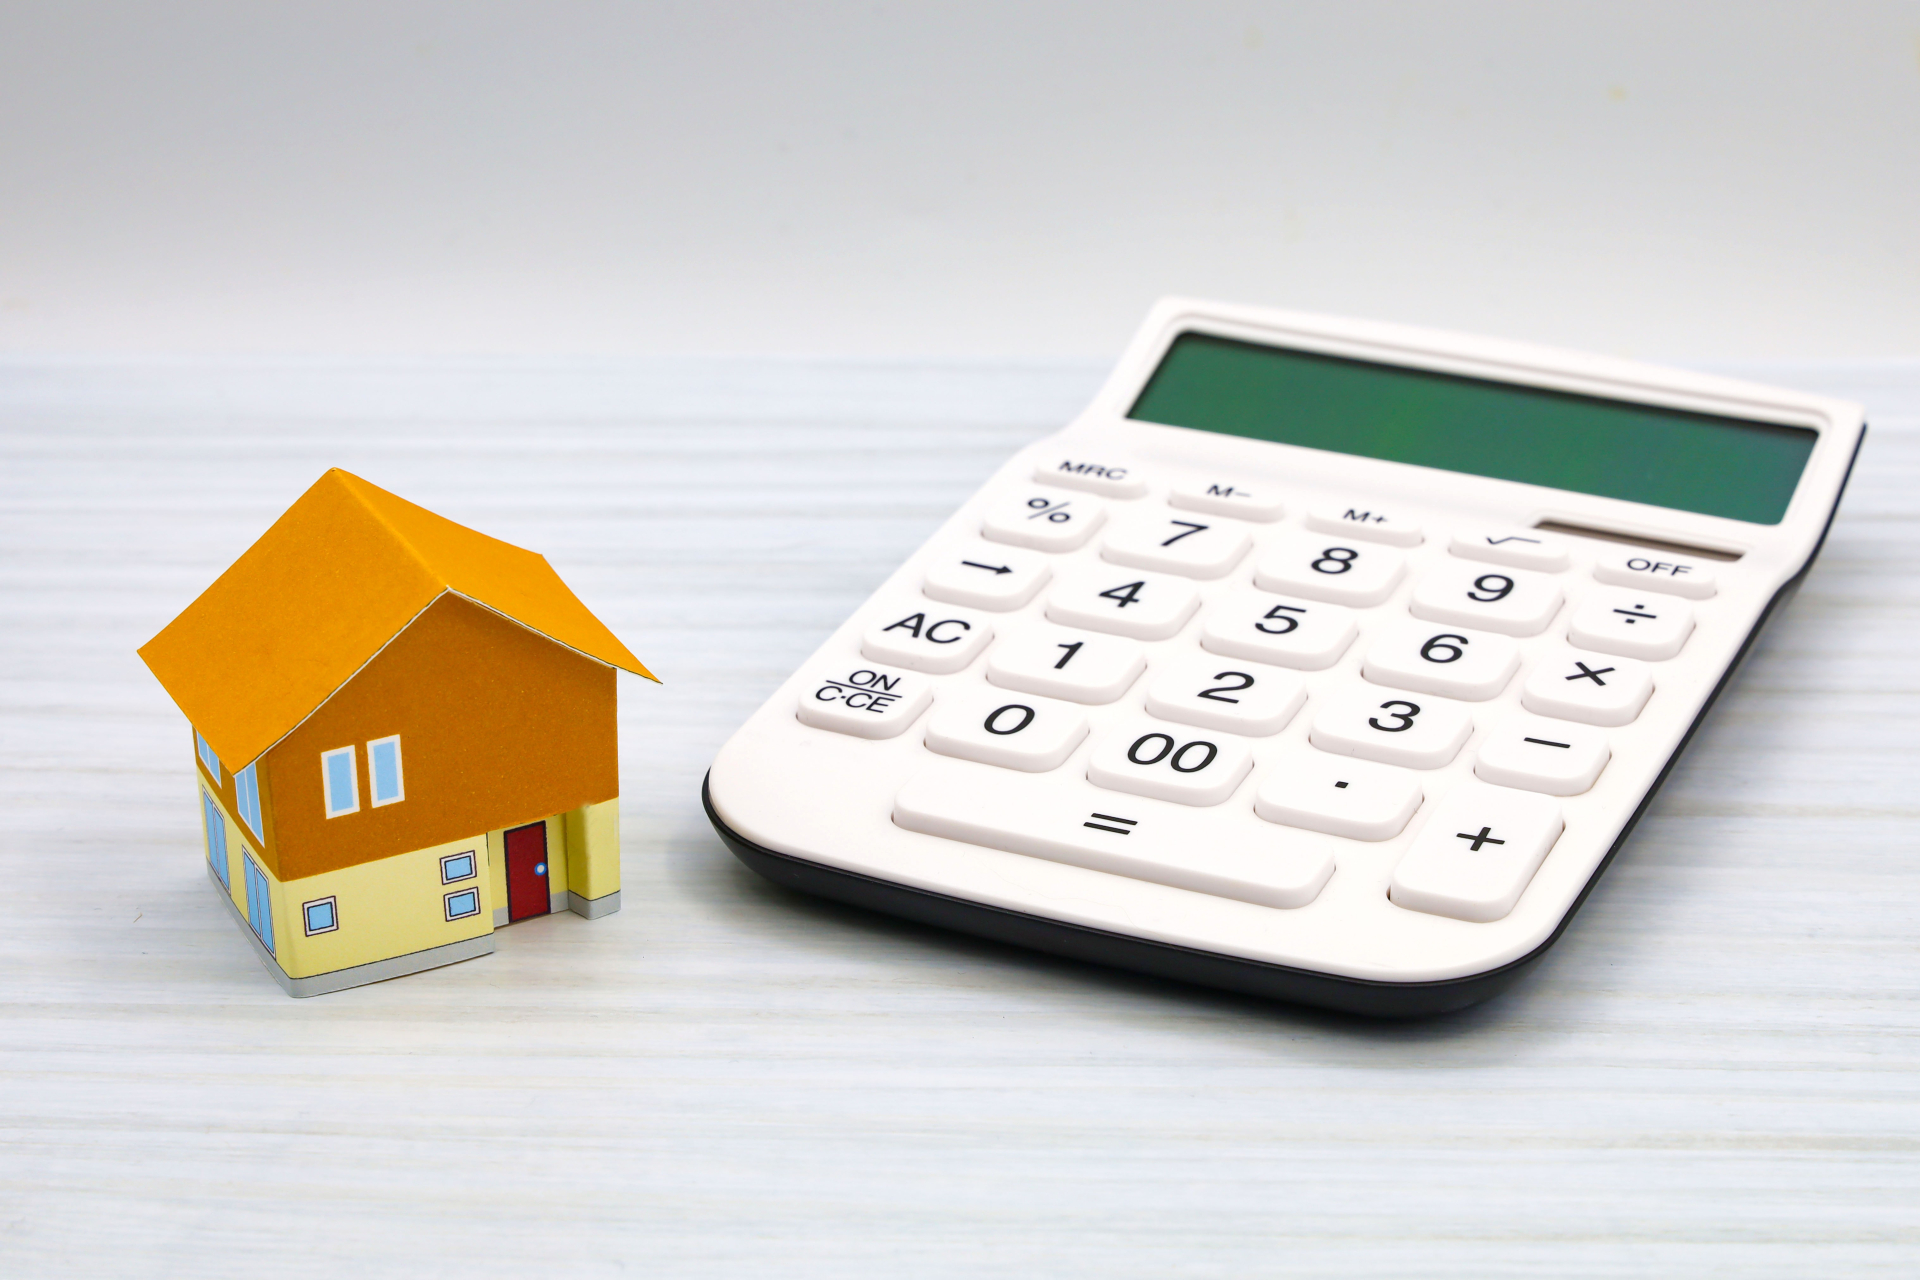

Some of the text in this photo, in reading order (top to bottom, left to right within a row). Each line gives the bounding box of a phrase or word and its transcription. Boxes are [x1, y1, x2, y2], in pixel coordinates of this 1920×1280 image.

[1058, 460, 1127, 481] MRC
[1028, 499, 1070, 523] %
[1161, 521, 1209, 546] 7
[1311, 547, 1358, 574] 8
[1627, 558, 1692, 577] OFF
[1099, 581, 1145, 608] 4
[1467, 574, 1514, 602] 9
[883, 613, 971, 644] AC
[1255, 605, 1306, 634] 5
[1054, 642, 1084, 669] 1
[1420, 634, 1468, 663] 6
[849, 670, 901, 691] ON
[1197, 672, 1254, 704] 2
[984, 704, 1035, 735] 0
[1369, 701, 1420, 732] 3
[1127, 733, 1217, 773] 00
[1083, 813, 1138, 835] =
[1456, 827, 1505, 851] +
